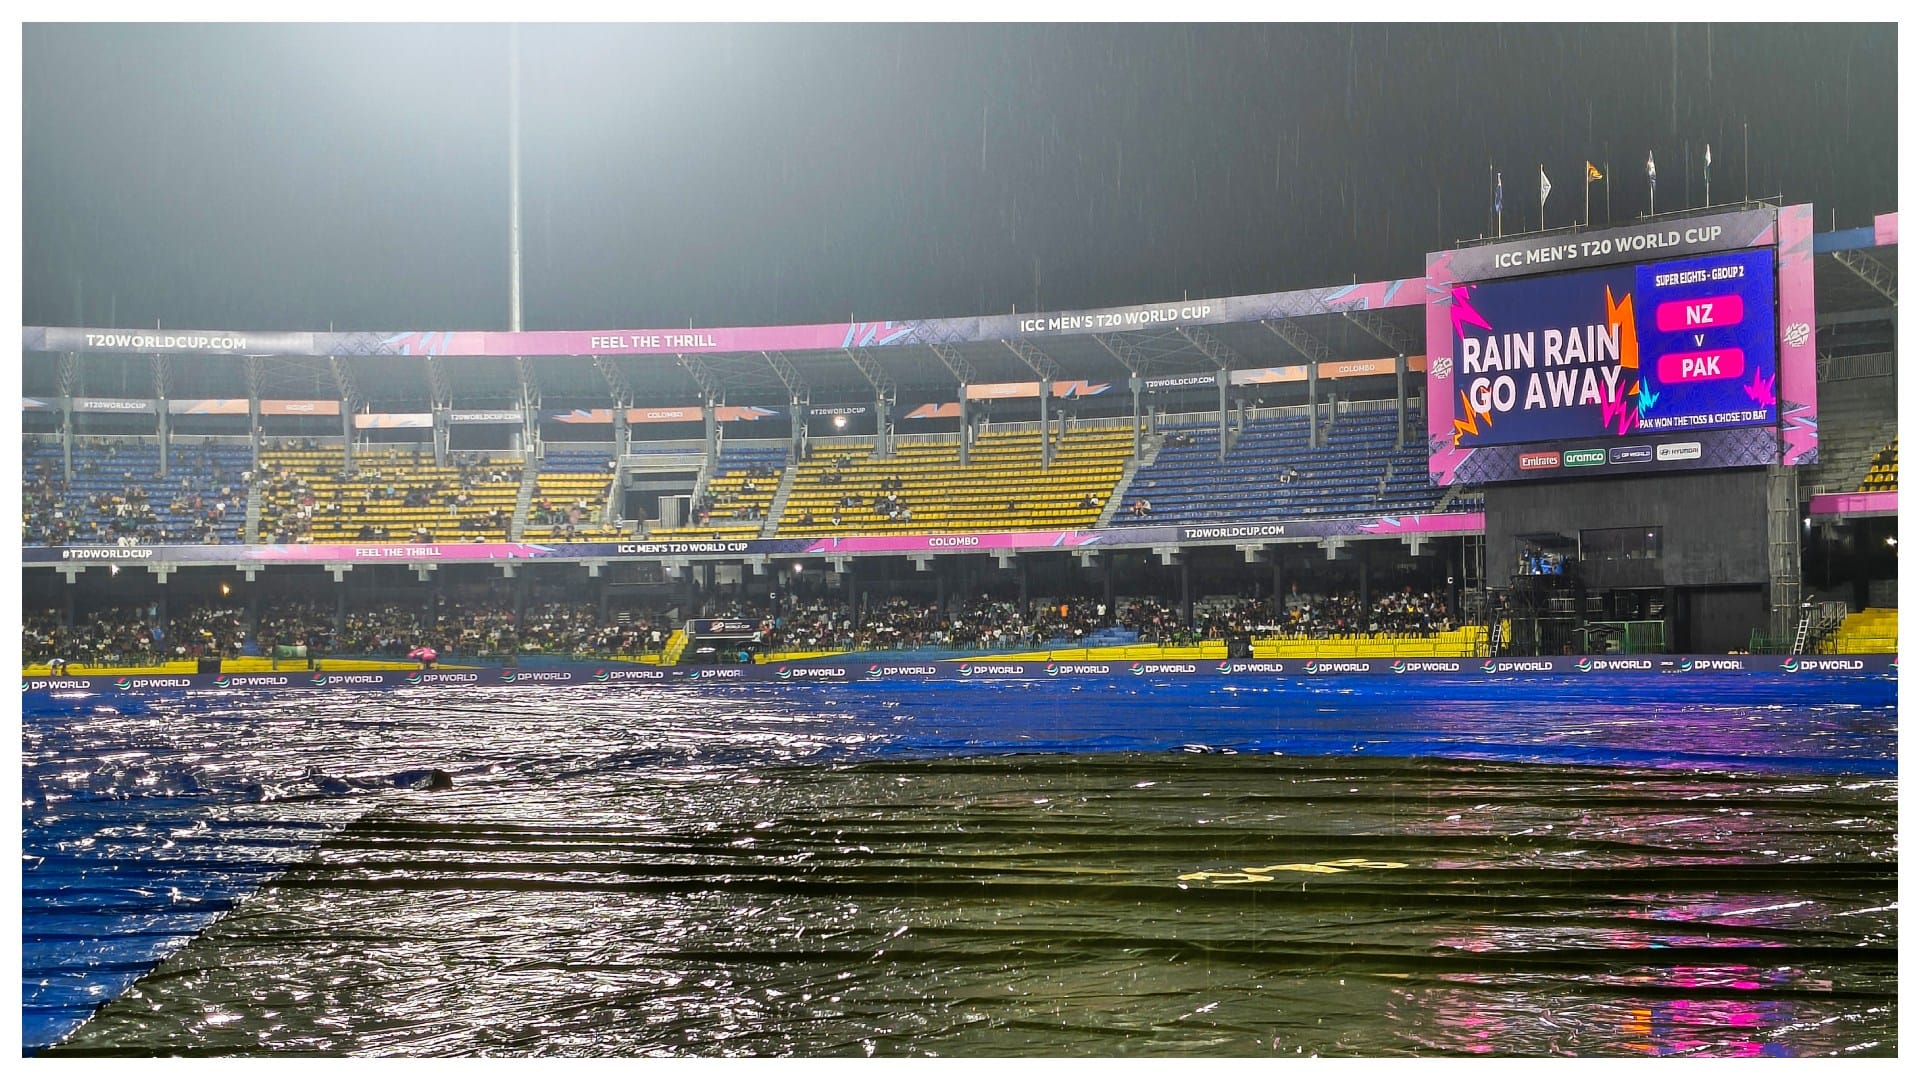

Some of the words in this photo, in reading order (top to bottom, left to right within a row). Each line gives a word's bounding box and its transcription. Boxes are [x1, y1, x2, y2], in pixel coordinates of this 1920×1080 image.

[1496, 252, 1522, 268] ICC
[1581, 240, 1611, 257] T20
[1616, 231, 1680, 252] WORLD
[1685, 226, 1721, 243] CUP
[1656, 274, 1679, 286] SUPER
[1680, 270, 1706, 284] EIGHTS
[1712, 267, 1738, 280] GROUP
[1739, 266, 1744, 277] 2
[1020, 319, 1045, 332] ICC
[1049, 315, 1093, 330] MEN'S
[1096, 313, 1120, 327] T20
[1125, 309, 1178, 325] WORLD
[1182, 306, 1210, 319] CUP
[1687, 304, 1713, 325] NZ
[86, 334, 246, 349] T20WORLDCUP.COM
[592, 336, 628, 348] FEEL
[631, 336, 660, 347] THE
[664, 335, 716, 347] THRILL
[1464, 332, 1534, 374] RAIN
[1544, 323, 1620, 366] RAIN
[1338, 364, 1375, 373] COLOMBO
[1682, 356, 1720, 378] PAK
[1146, 376, 1215, 388] T20WORLDCUP.COM
[1470, 375, 1516, 414] GO
[1524, 365, 1621, 410] AWAY
[1640, 418, 1653, 428] PAK
[1655, 418, 1673, 427] WON
[1674, 417, 1688, 426] THE
[1690, 415, 1707, 425] TOSS
[1715, 412, 1740, 422] CHOSE
[1741, 411, 1752, 421] TO
[1753, 410, 1767, 420] BAT
[1522, 456, 1558, 466] Emirates
[1566, 453, 1603, 462] aramco
[1185, 526, 1284, 538] T20WORLDCUP.COM
[929, 536, 978, 546] COLOMBO
[356, 548, 381, 556] FEEL
[383, 548, 404, 556] THE
[406, 547, 441, 556] THRILL
[618, 545, 635, 553] ICC
[690, 544, 725, 552] WORLD
[728, 543, 748, 551] CUP
[63, 550, 152, 559] #T20WORLDCUP
[1145, 665, 1159, 673] DP
[1159, 665, 1195, 673] WORLD
[1234, 664, 1247, 672] DP
[1248, 664, 1283, 672] WORLD
[1320, 663, 1333, 672] DP
[1334, 663, 1369, 672] WORLD
[1407, 663, 1421, 671] DP
[1422, 663, 1459, 671] WORLD
[1498, 662, 1512, 671] DP
[1514, 662, 1552, 671] WORLD
[1594, 661, 1607, 669] DP
[1609, 661, 1651, 669] WORLD
[1695, 660, 1710, 669] DP
[1801, 660, 1818, 669] DP
[1819, 660, 1863, 669] WORLD
[793, 668, 807, 676] DP
[808, 668, 845, 676] WORLD
[974, 666, 987, 674] DP
[987, 666, 1023, 674] WORLD
[232, 677, 246, 686] DP
[248, 677, 287, 686] WORLD
[424, 673, 438, 681] DP
[439, 673, 477, 681] WORLD
[133, 679, 148, 688] DP
[150, 679, 190, 688] WORLD
